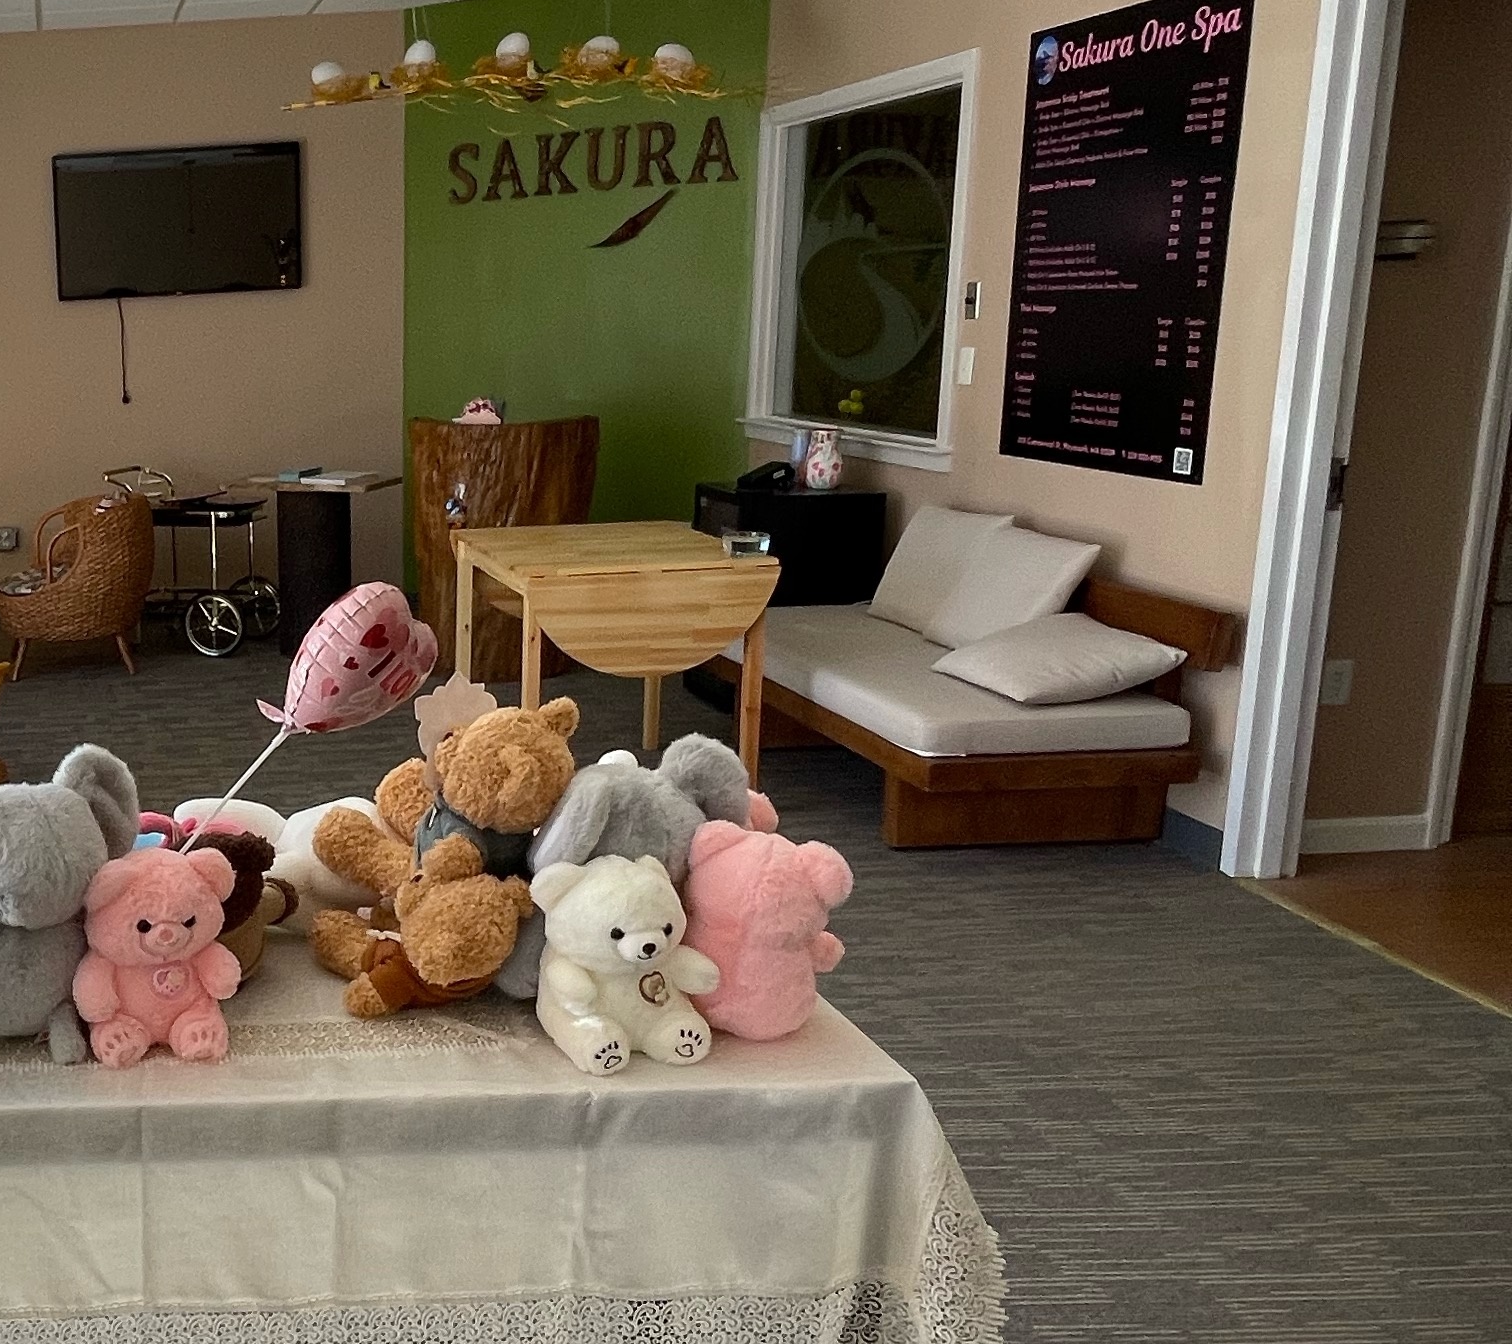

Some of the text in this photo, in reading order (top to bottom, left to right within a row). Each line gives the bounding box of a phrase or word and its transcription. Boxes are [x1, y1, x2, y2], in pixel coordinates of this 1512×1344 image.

[1059, 5, 1242, 72] Sakura One Spa
[448, 115, 739, 205] SAKURA
